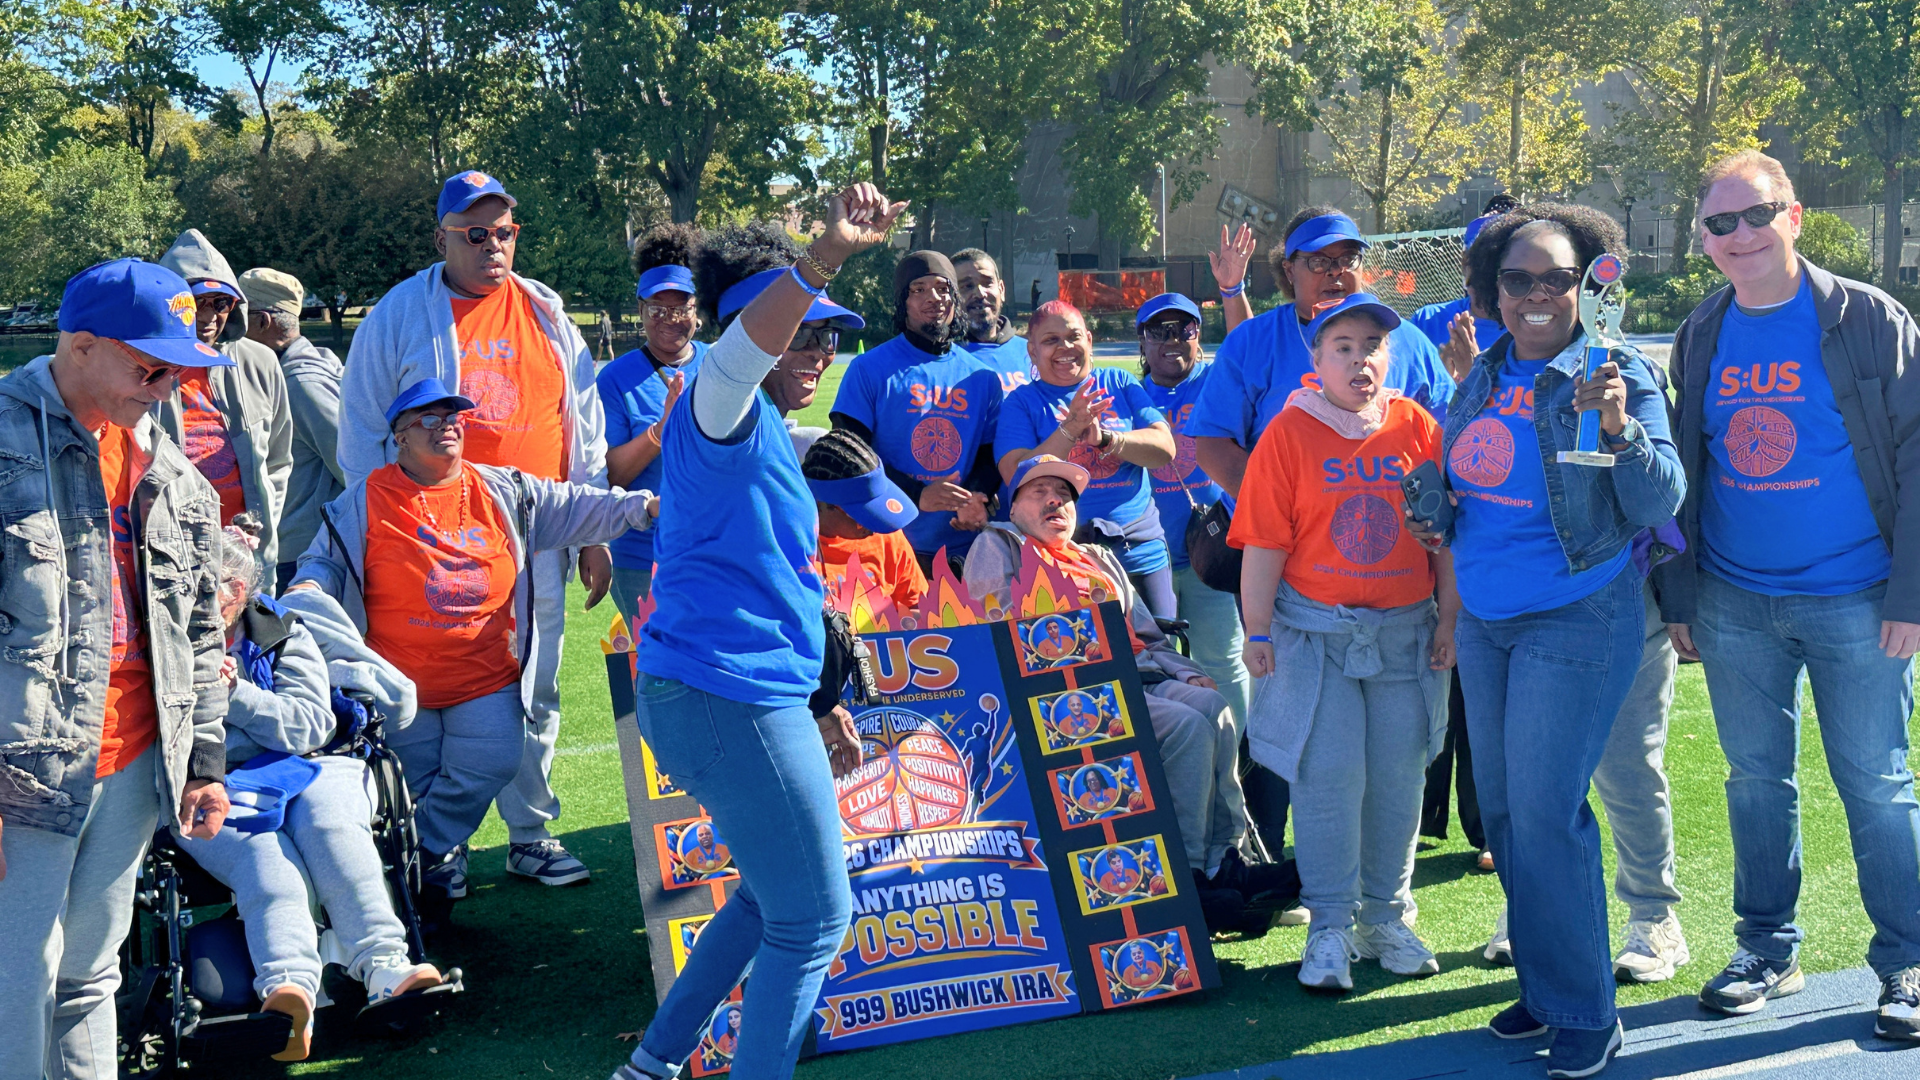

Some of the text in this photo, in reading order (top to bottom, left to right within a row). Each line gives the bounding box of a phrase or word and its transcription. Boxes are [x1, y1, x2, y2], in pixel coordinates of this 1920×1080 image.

[1718, 361, 1801, 396] S:US
[910, 383, 968, 411] S:US
[1322, 455, 1405, 483] S:US
[841, 633, 960, 694] US
[893, 689, 966, 704] UNDERSERVED
[863, 743, 876, 755] PE
[905, 737, 947, 756] PEACE
[904, 757, 961, 785] POSITIVITY
[847, 780, 888, 814] LOVE
[907, 775, 959, 805] HAPPINESS
[859, 804, 893, 829] HUMILITY
[917, 801, 951, 826] RESPECT
[842, 830, 1024, 868] 26 CHAMPIONSHIPS
[850, 873, 1007, 915] ANYTHING IS
[828, 899, 1048, 981] POSSIBLE
[839, 971, 1055, 1030] 999 BUSHWICK IRA
